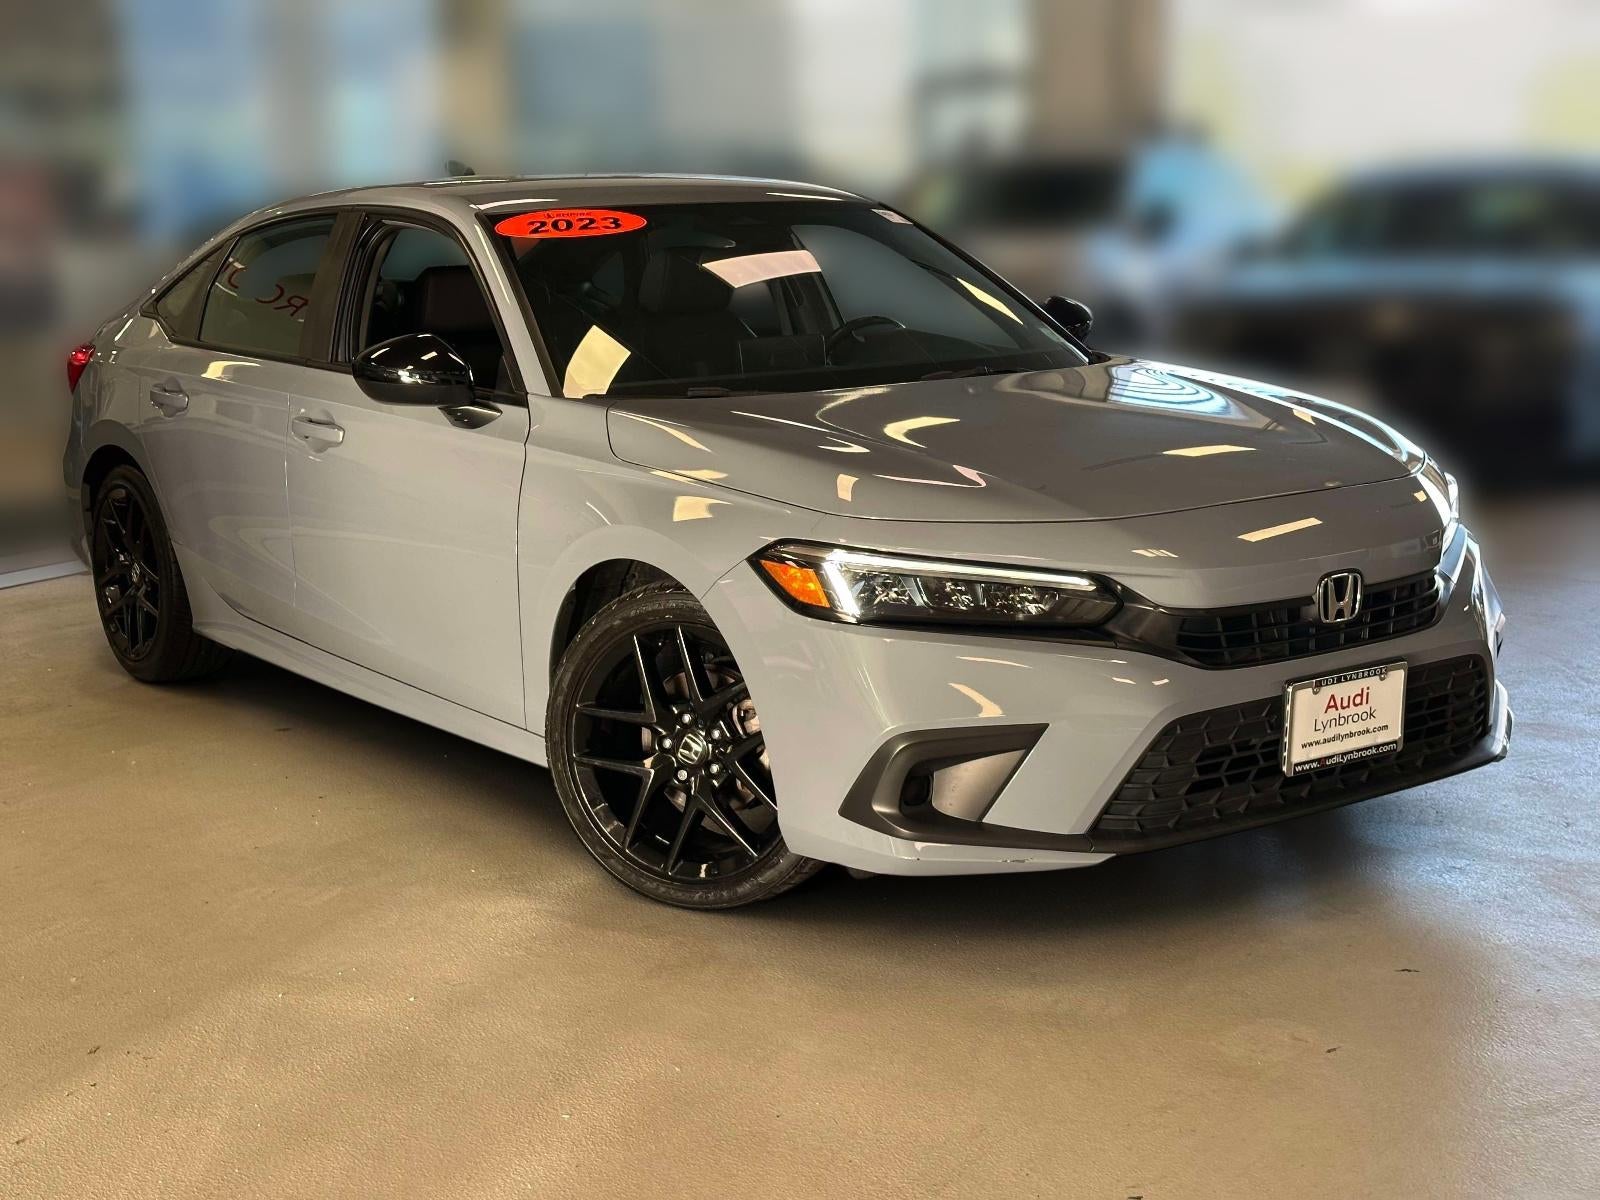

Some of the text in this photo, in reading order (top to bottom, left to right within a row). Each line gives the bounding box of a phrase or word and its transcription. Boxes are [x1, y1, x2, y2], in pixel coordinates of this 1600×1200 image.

[527, 216, 623, 235] 2023
[1341, 667, 1388, 682] LYNBROOK
[1324, 686, 1370, 714] Audi
[1313, 707, 1377, 733] Lynbrook
[1301, 724, 1389, 749] www.audilynbrook.com
